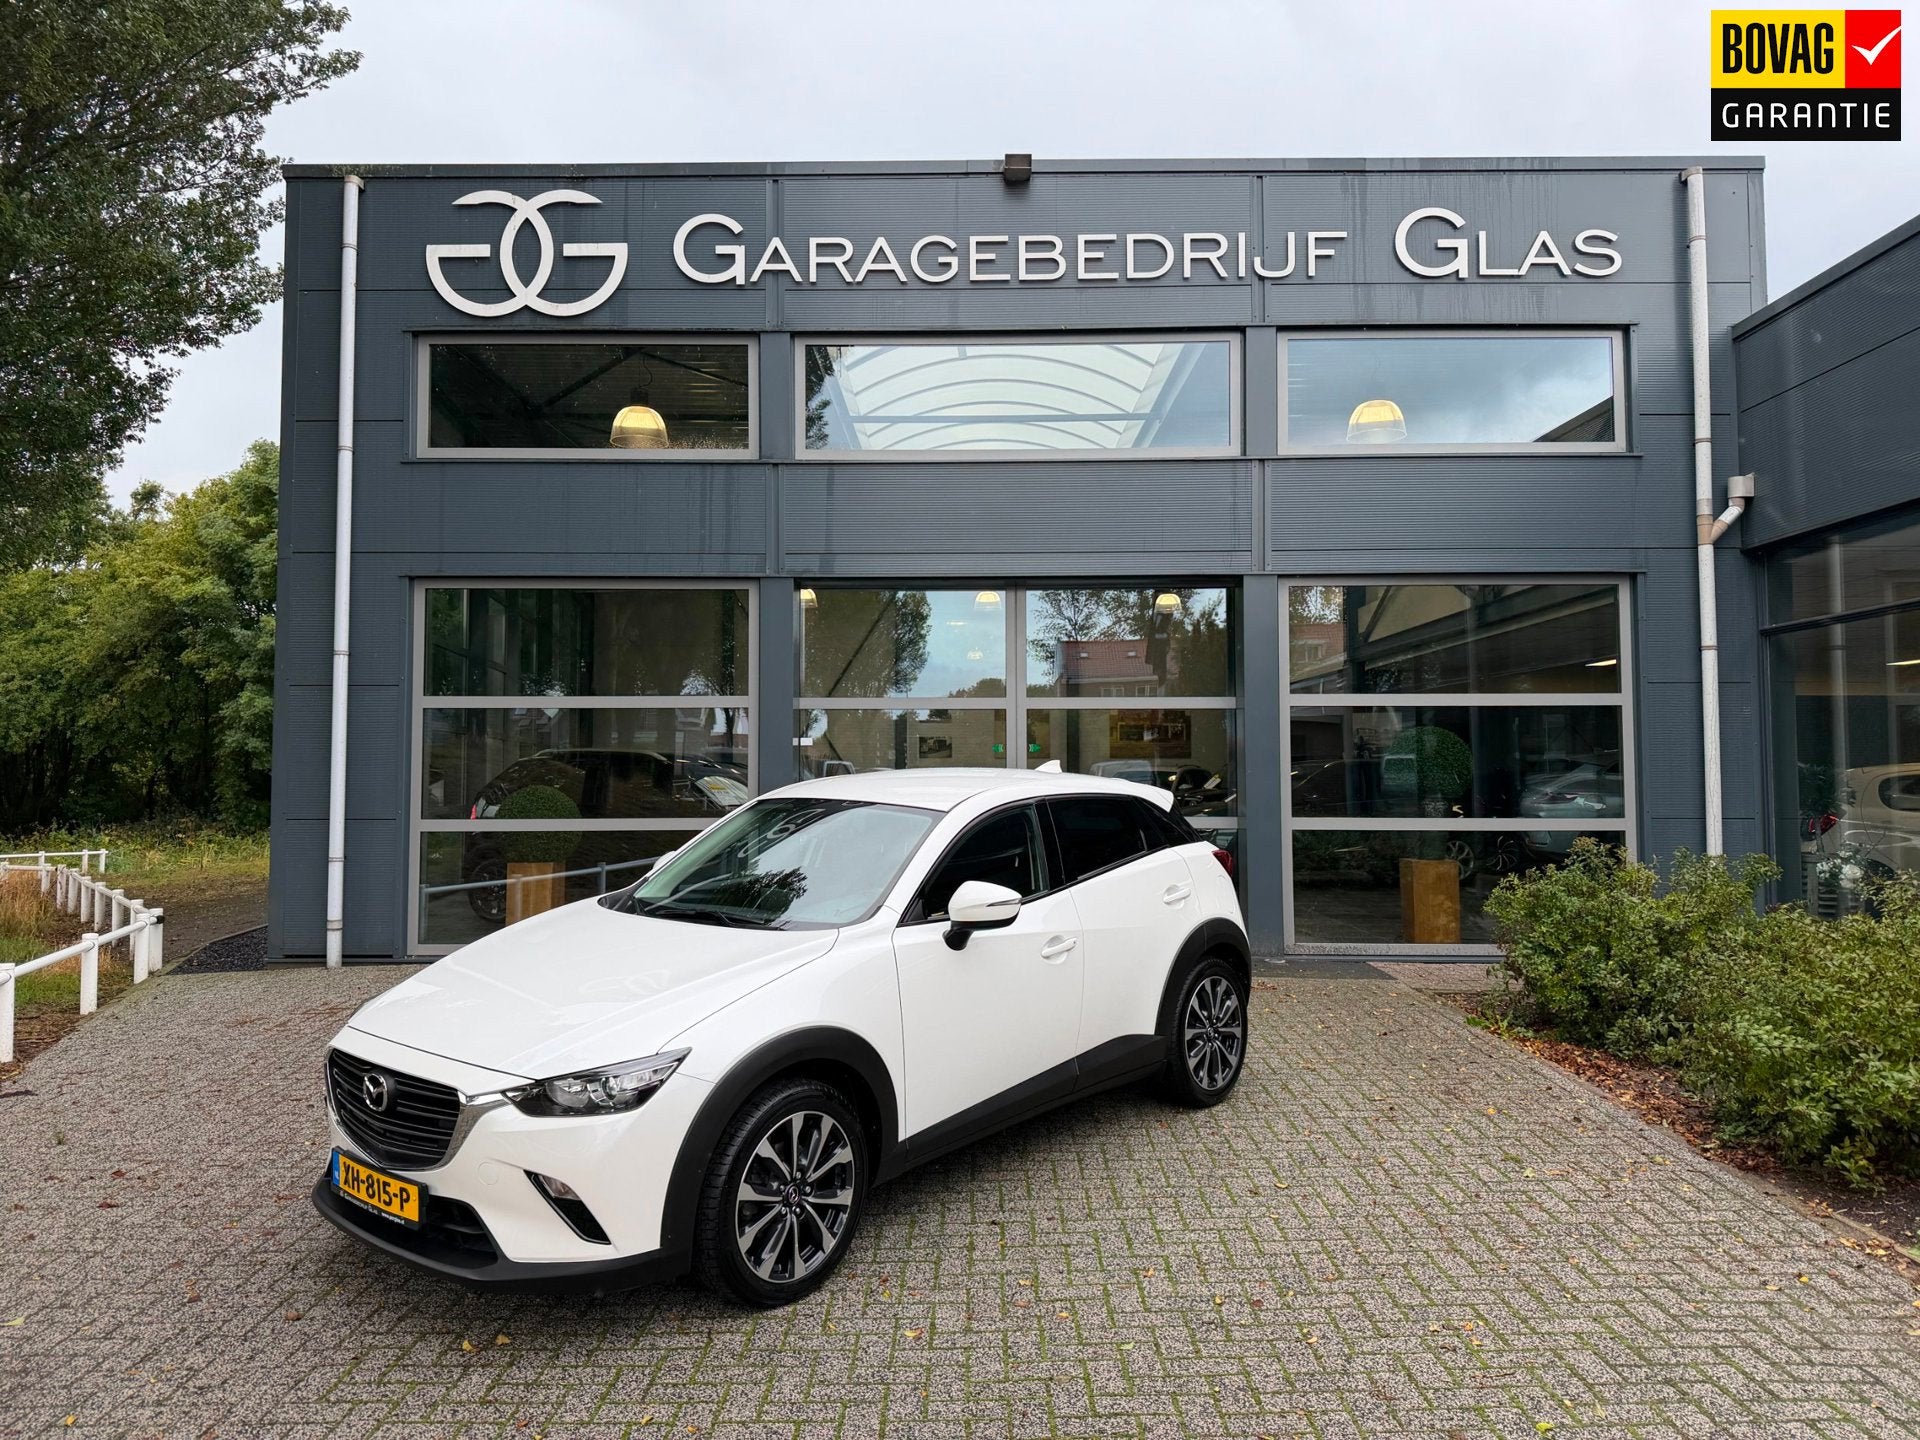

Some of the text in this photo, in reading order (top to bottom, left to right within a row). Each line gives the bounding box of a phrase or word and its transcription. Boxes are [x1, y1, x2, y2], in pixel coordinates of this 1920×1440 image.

[673, 206, 1624, 286] GARAGEBEDRIJF GLAS
[343, 1161, 411, 1212] XH-815-P
